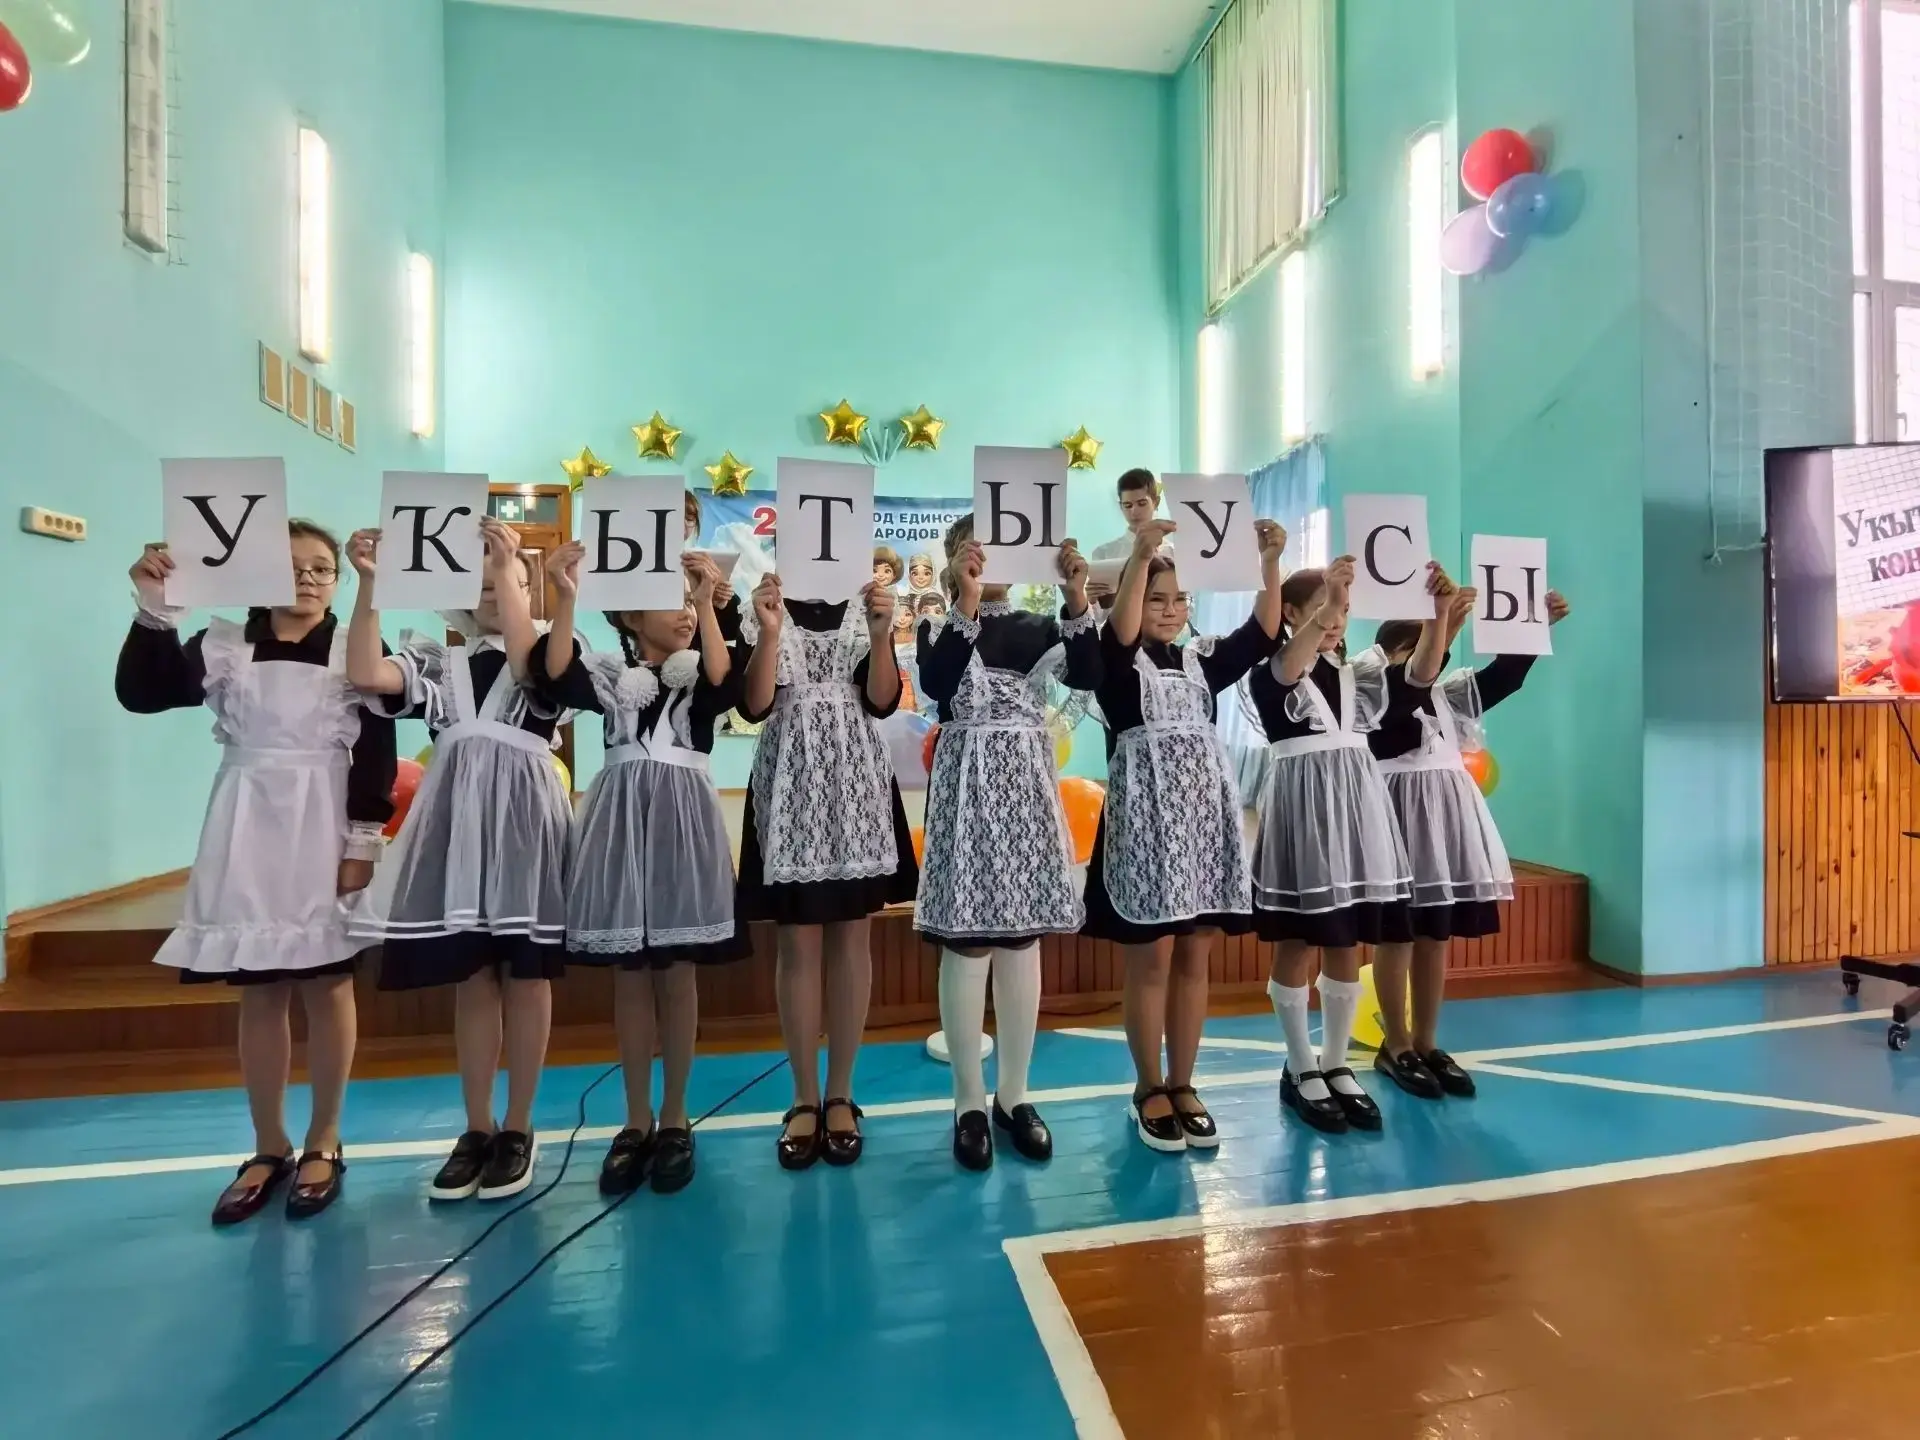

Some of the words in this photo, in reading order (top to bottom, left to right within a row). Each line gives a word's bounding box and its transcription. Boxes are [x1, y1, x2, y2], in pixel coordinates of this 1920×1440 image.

[183, 494, 267, 567] У
[587, 509, 676, 573] Ы
[799, 494, 854, 562] Т
[873, 512, 894, 524] ОД
[899, 513, 967, 524] ЕДИНСТ
[874, 528, 940, 541] АРОДОВ
[982, 481, 1061, 548] Ы
[1180, 501, 1239, 559] У
[1364, 524, 1417, 586] С
[1478, 564, 1543, 623] Ы
